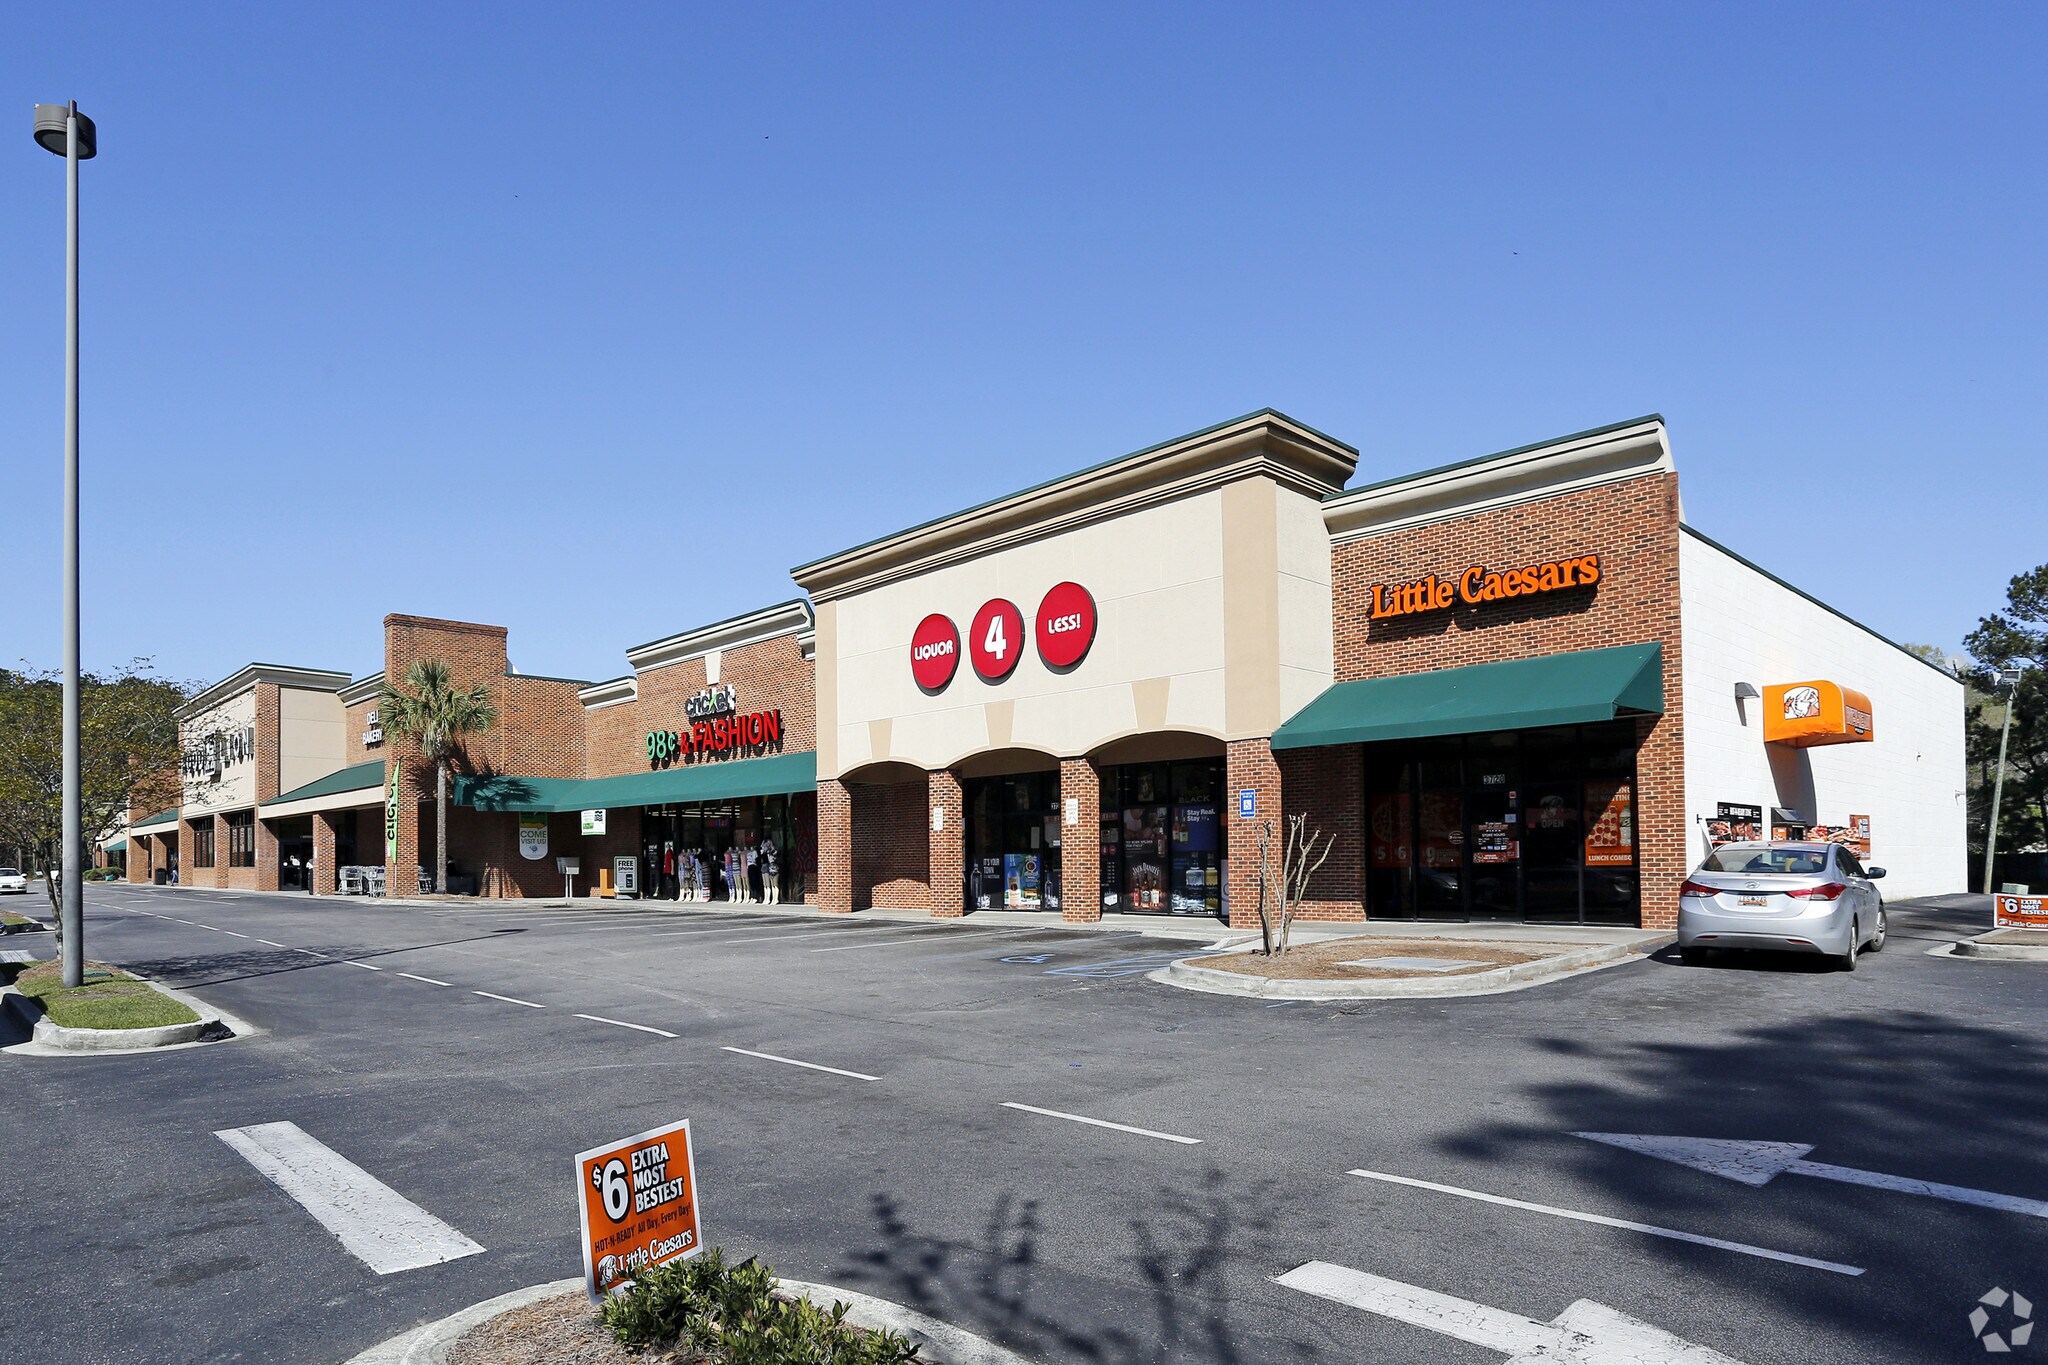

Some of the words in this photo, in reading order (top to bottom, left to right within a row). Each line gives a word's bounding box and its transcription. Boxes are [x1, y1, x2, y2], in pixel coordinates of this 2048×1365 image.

[1369, 572, 1454, 619] Little
[1459, 554, 1600, 604] Caesars
[914, 639, 953, 661] LIQUOR
[983, 614, 1007, 660] 4
[1047, 612, 1081, 634] LESS!
[685, 685, 735, 717] cricket
[366, 709, 380, 725] DELI
[680, 731, 691, 755] &
[693, 708, 780, 752] FASHION
[362, 728, 384, 746] BAKERY
[520, 830, 547, 838] COME
[1186, 815, 1201, 823] Stay
[1541, 819, 1565, 829] OPEN
[1609, 853, 1633, 861] COMBO
[630, 1141, 670, 1169] EXTRA
[592, 1159, 629, 1220] $6
[633, 1163, 667, 1193] MOST
[634, 1176, 684, 1214] BESTEST
[594, 1227, 635, 1254] HOT-N-READY
[637, 1221, 646, 1235] All
[660, 1207, 678, 1225] Every
[678, 1202, 692, 1219] Day!
[617, 1245, 649, 1272] Little
[649, 1228, 693, 1262] Caesars
